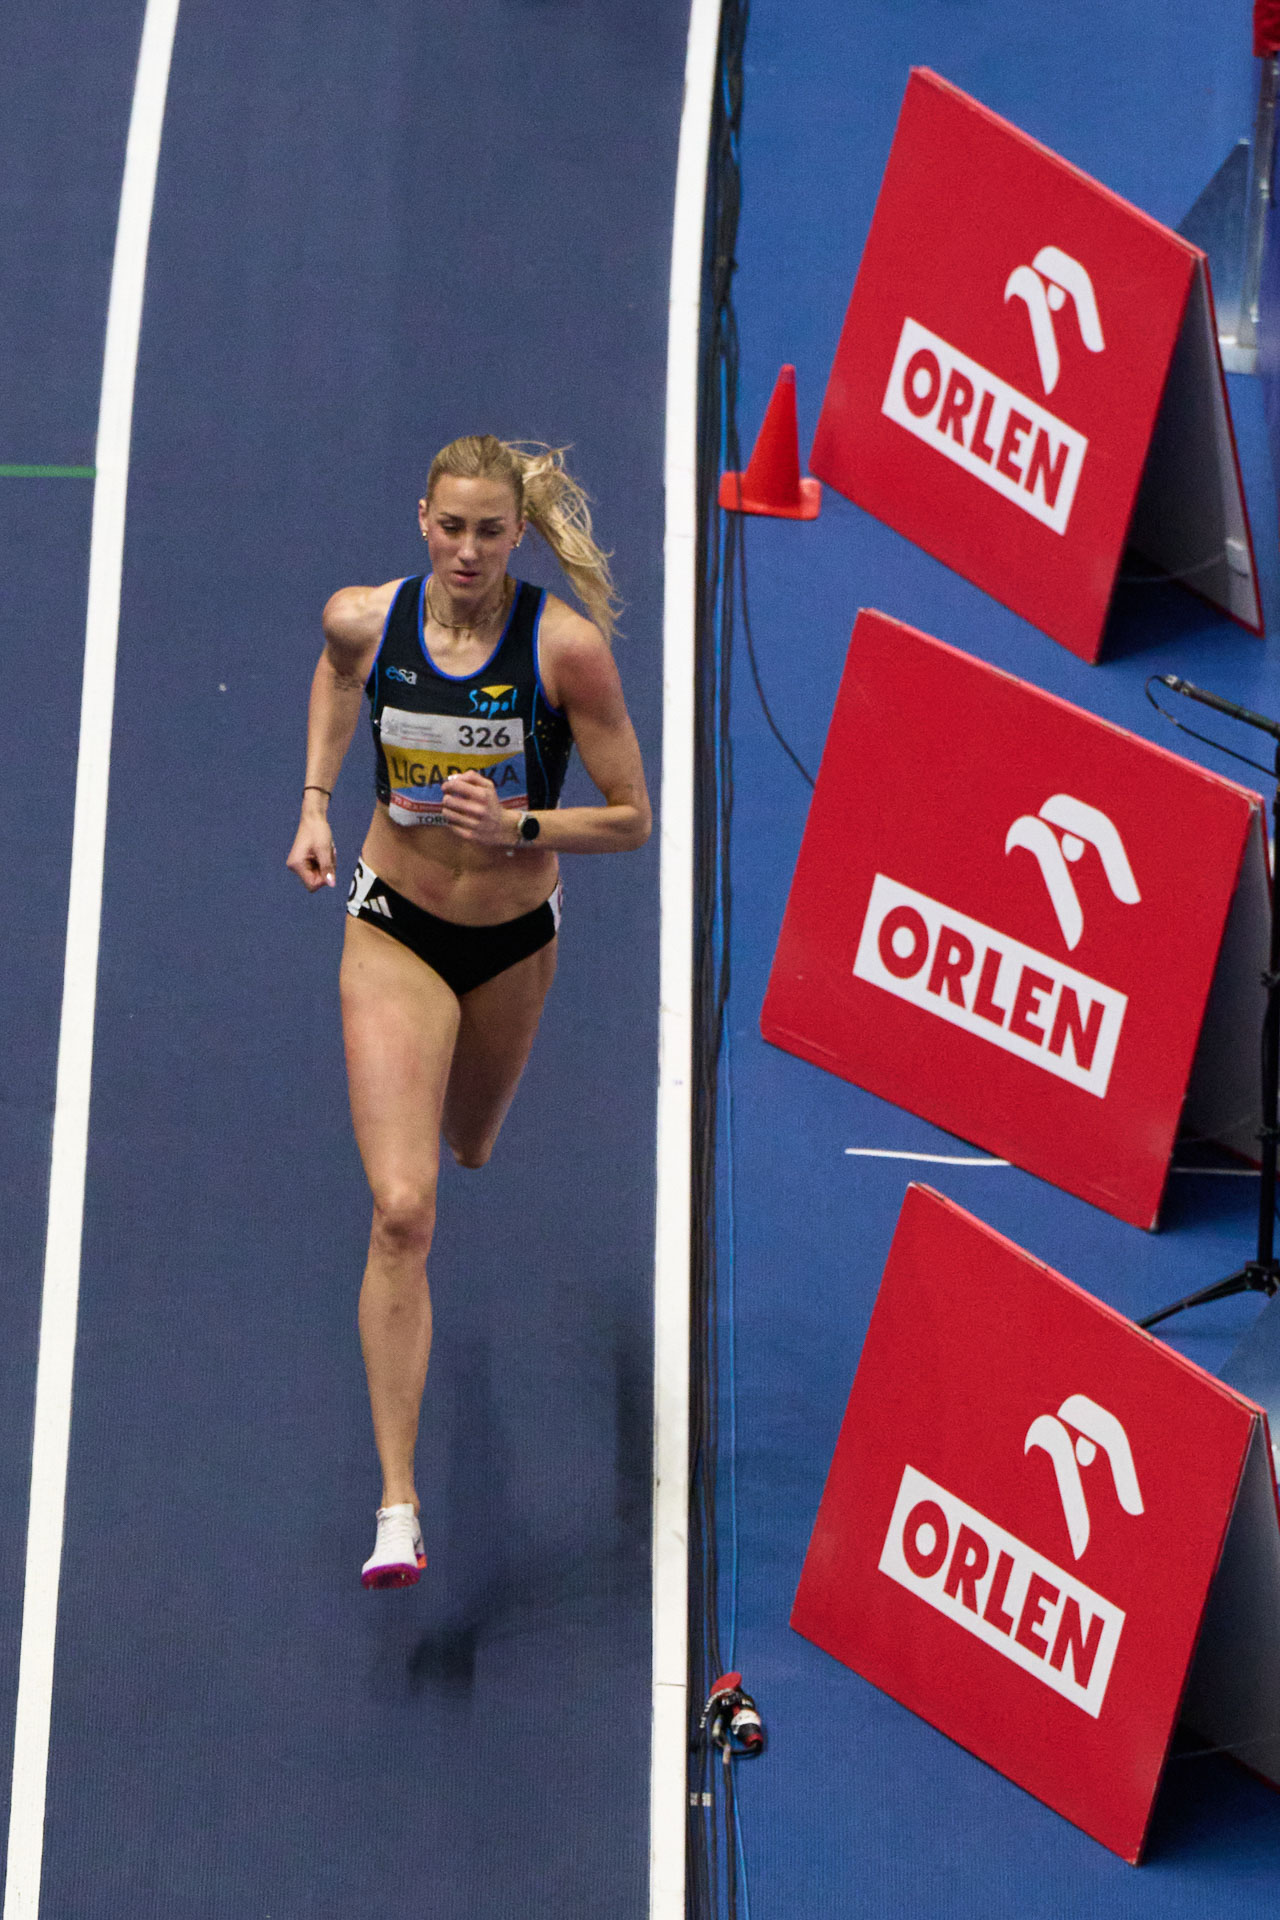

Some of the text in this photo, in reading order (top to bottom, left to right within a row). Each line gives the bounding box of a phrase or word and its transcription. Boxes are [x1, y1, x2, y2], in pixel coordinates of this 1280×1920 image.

[903, 347, 1073, 508] ORLEN
[385, 666, 417, 685] esa
[390, 756, 520, 789] LIGAKA
[458, 725, 511, 748] 326
[877, 905, 1105, 1073] ORLEN
[902, 1499, 1105, 1691] ORLEN
